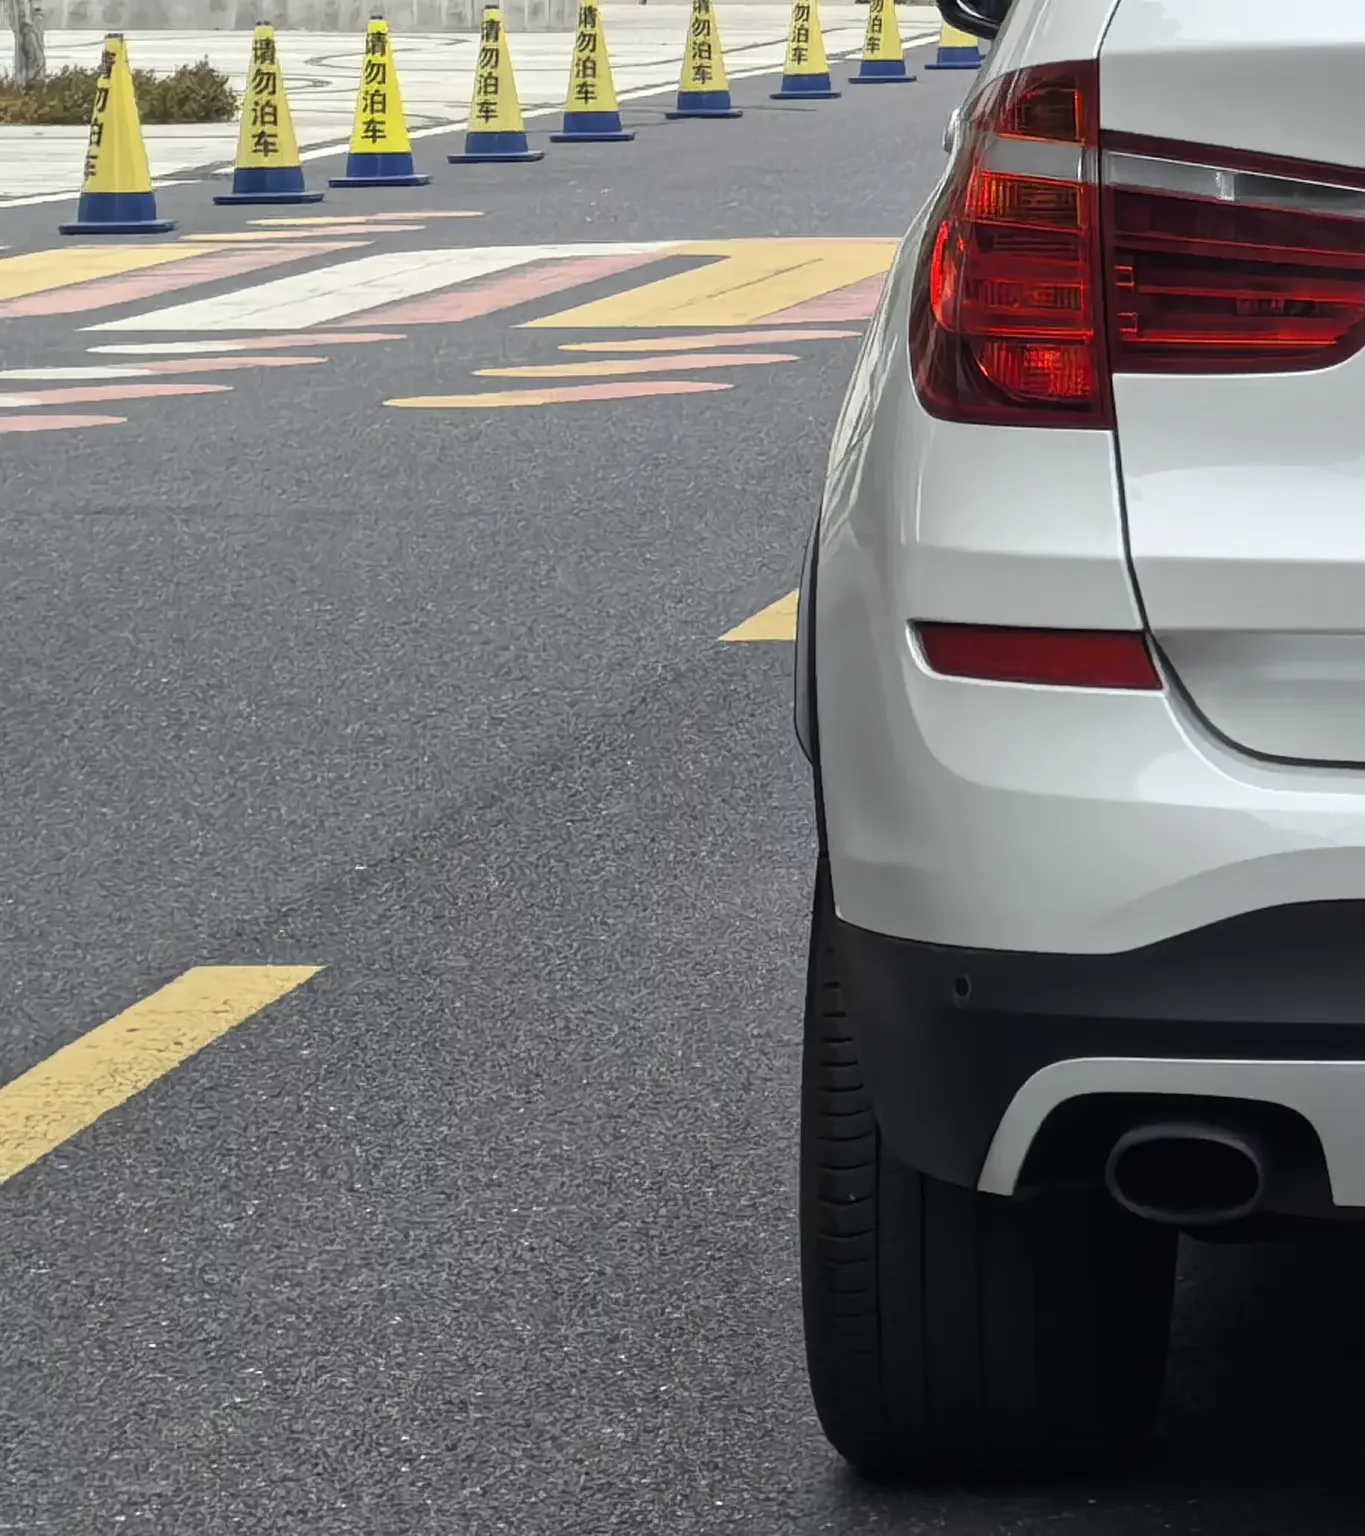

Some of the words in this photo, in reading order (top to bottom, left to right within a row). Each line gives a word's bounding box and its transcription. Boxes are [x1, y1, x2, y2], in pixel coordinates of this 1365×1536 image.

[251, 38, 280, 158] 请勿泊车
[361, 31, 389, 144] 请勿泊车
[476, 19, 500, 124] 请勿泊车
[575, 5, 599, 105] 请勿泊车
